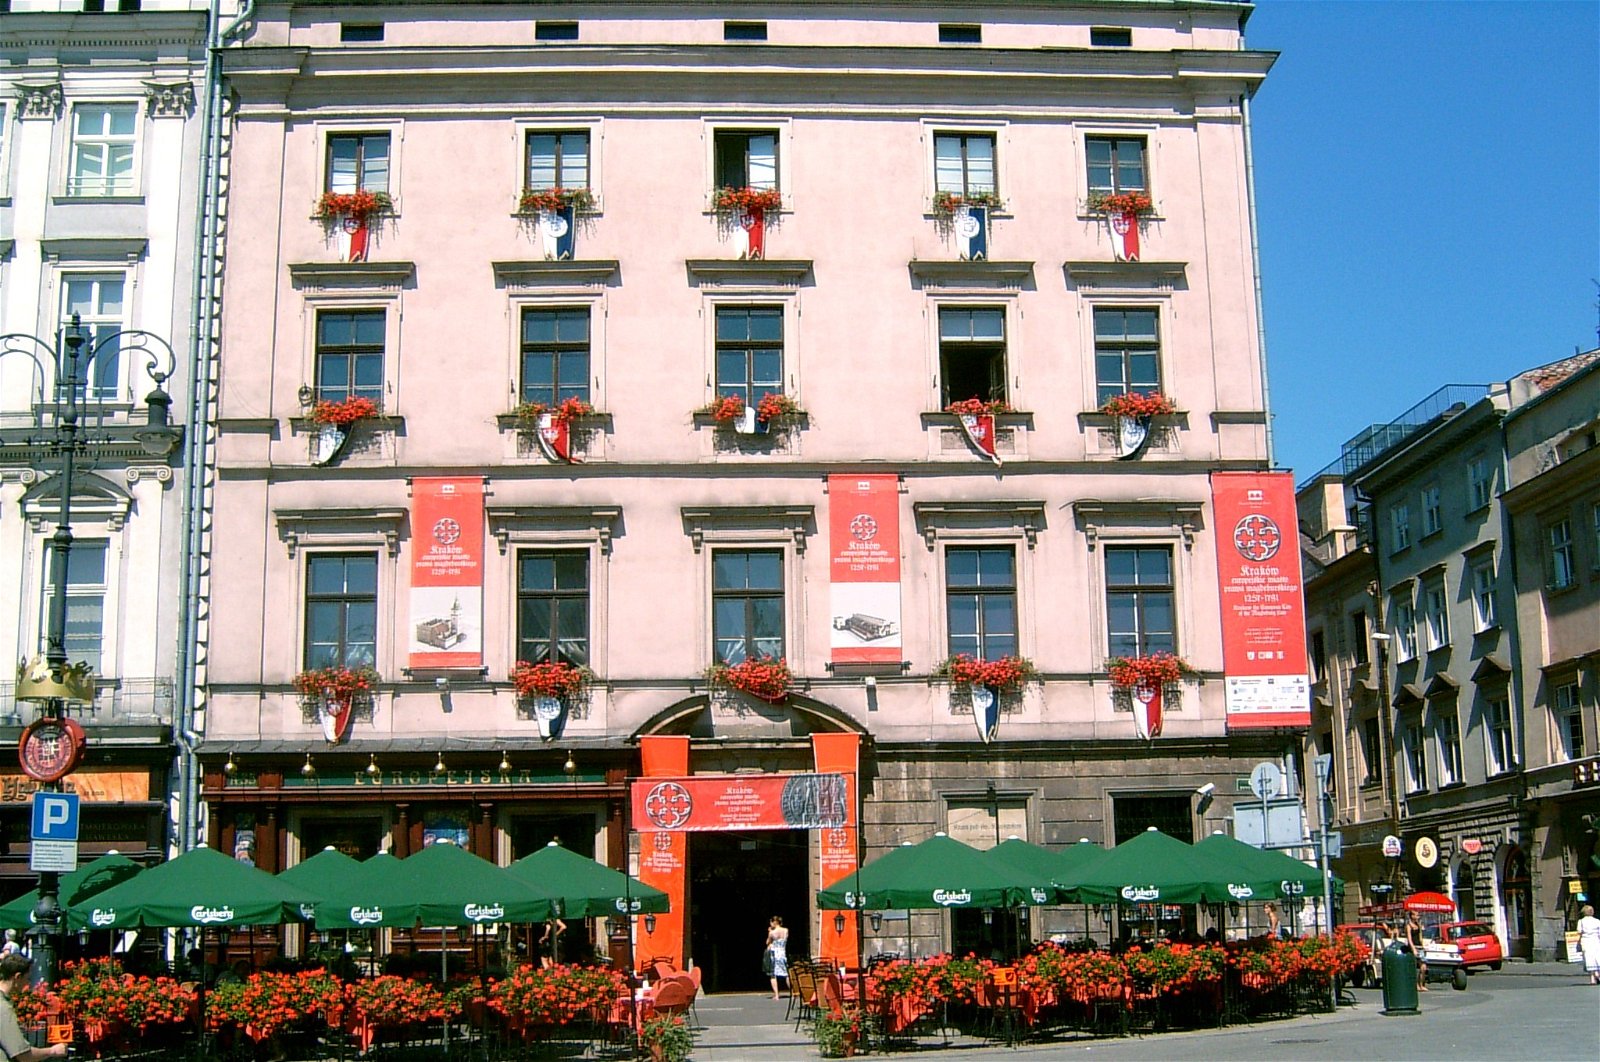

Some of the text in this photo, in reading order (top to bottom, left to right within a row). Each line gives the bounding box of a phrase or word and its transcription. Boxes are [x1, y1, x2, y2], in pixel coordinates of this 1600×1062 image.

[1240, 565, 1280, 577] Kraków
[1244, 594, 1280, 603] 1257-1791
[42, 798, 69, 834] P
[933, 888, 972, 906] Carlsberg
[1122, 884, 1160, 902] Carlsberg
[191, 905, 235, 924] Carlsberg
[350, 906, 383, 925] Carlsberg
[465, 903, 505, 922] Carlsberg
